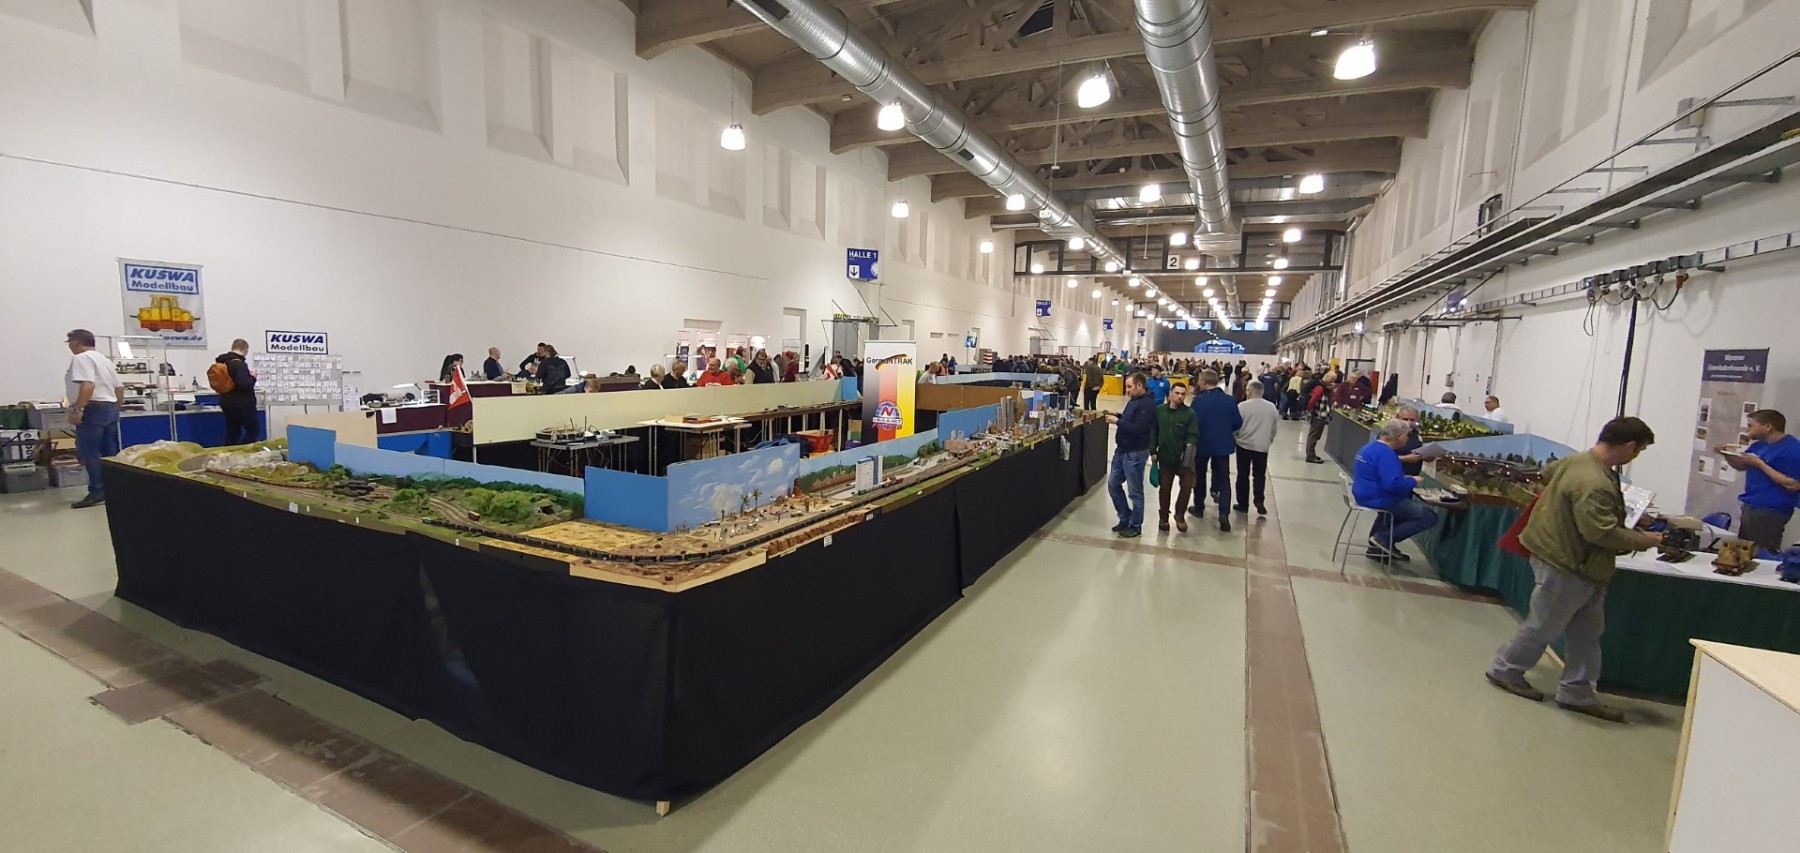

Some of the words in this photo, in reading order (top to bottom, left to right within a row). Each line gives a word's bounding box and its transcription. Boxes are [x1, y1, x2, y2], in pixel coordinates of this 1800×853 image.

[849, 250, 871, 258] HALLE
[1169, 257, 1178, 267] 2
[130, 268, 194, 282] KUSWA
[131, 280, 194, 291] Modellbau
[270, 334, 324, 344] KUSWA
[270, 344, 324, 352] Modellbau
